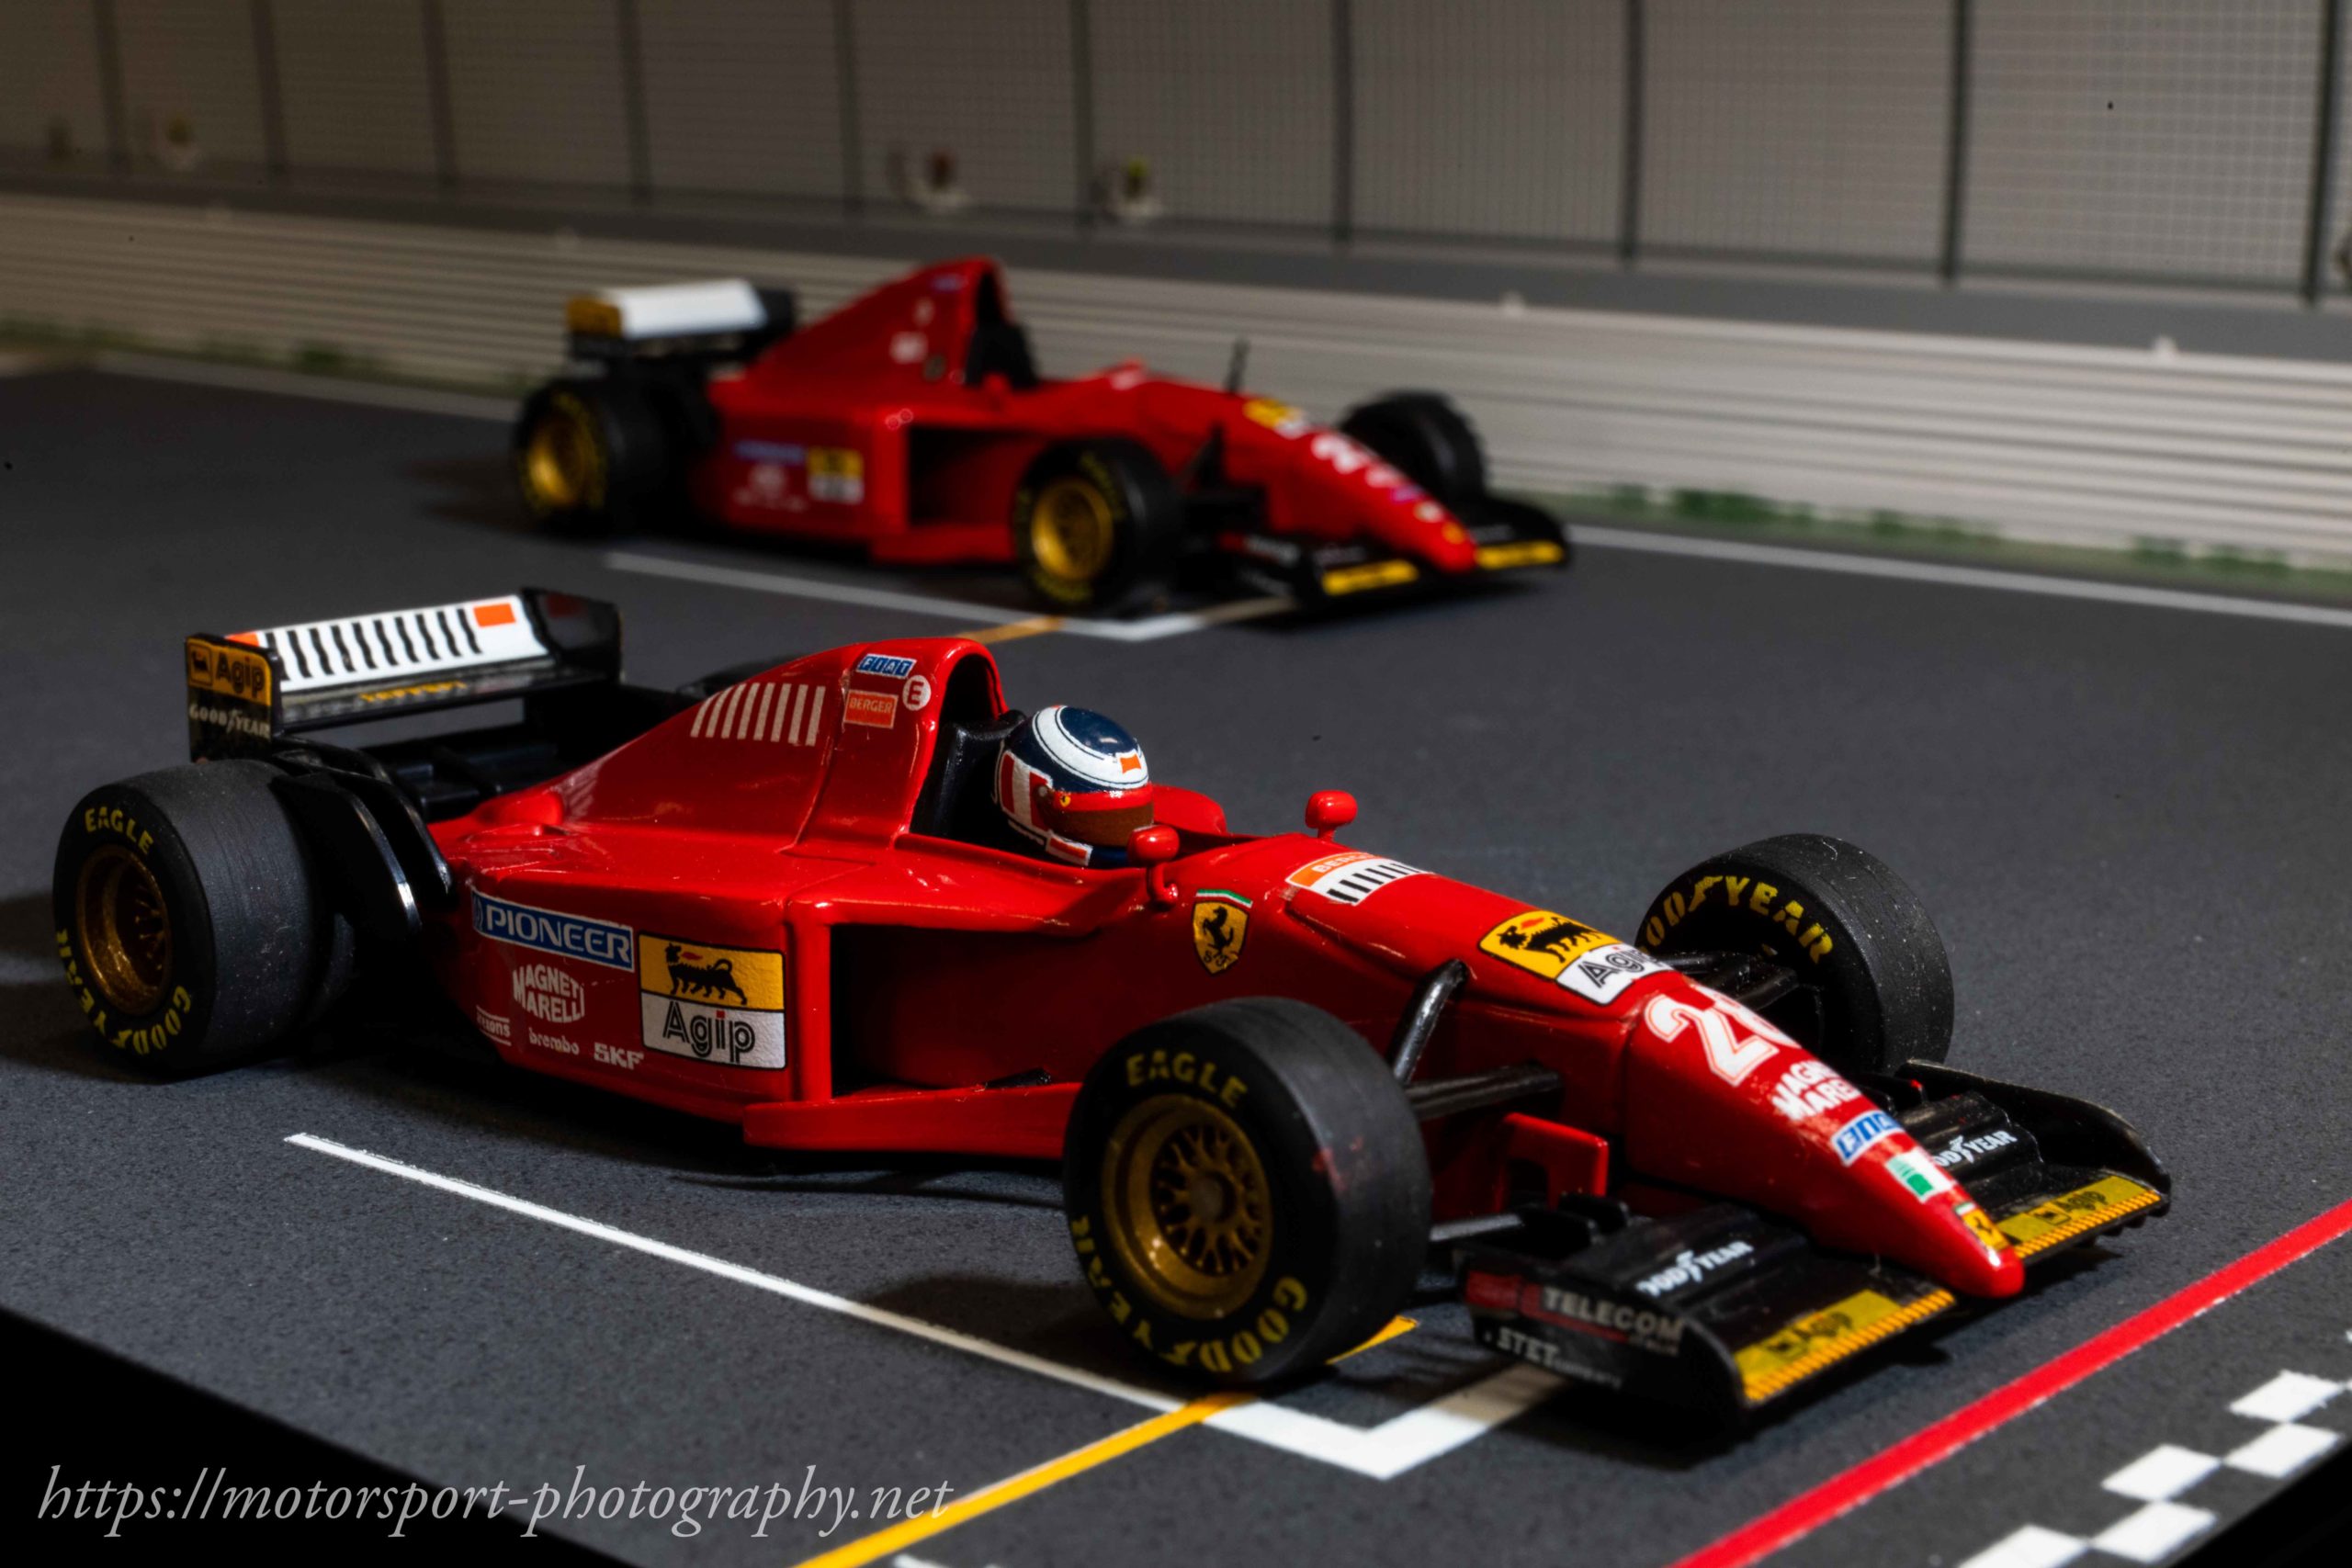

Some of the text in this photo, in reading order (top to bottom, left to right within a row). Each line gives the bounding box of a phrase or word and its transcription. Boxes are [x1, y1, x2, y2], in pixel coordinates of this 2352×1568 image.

[216, 651, 265, 698] Agip
[860, 656, 912, 677] FIAT
[907, 680, 924, 706] E
[848, 696, 893, 714] BERGER
[85, 806, 154, 855] EAGLE
[485, 903, 631, 964] PIONEER
[1643, 875, 1834, 964] ODYEAR
[55, 928, 192, 1055] GOODYEAR
[528, 1027, 645, 1070] brembo SKF
[662, 999, 756, 1064] Agip
[1125, 1049, 1248, 1109] EAGLE
[1070, 1214, 1308, 1373] GOODYEAR
[1541, 1286, 1685, 1340] TELECOM
